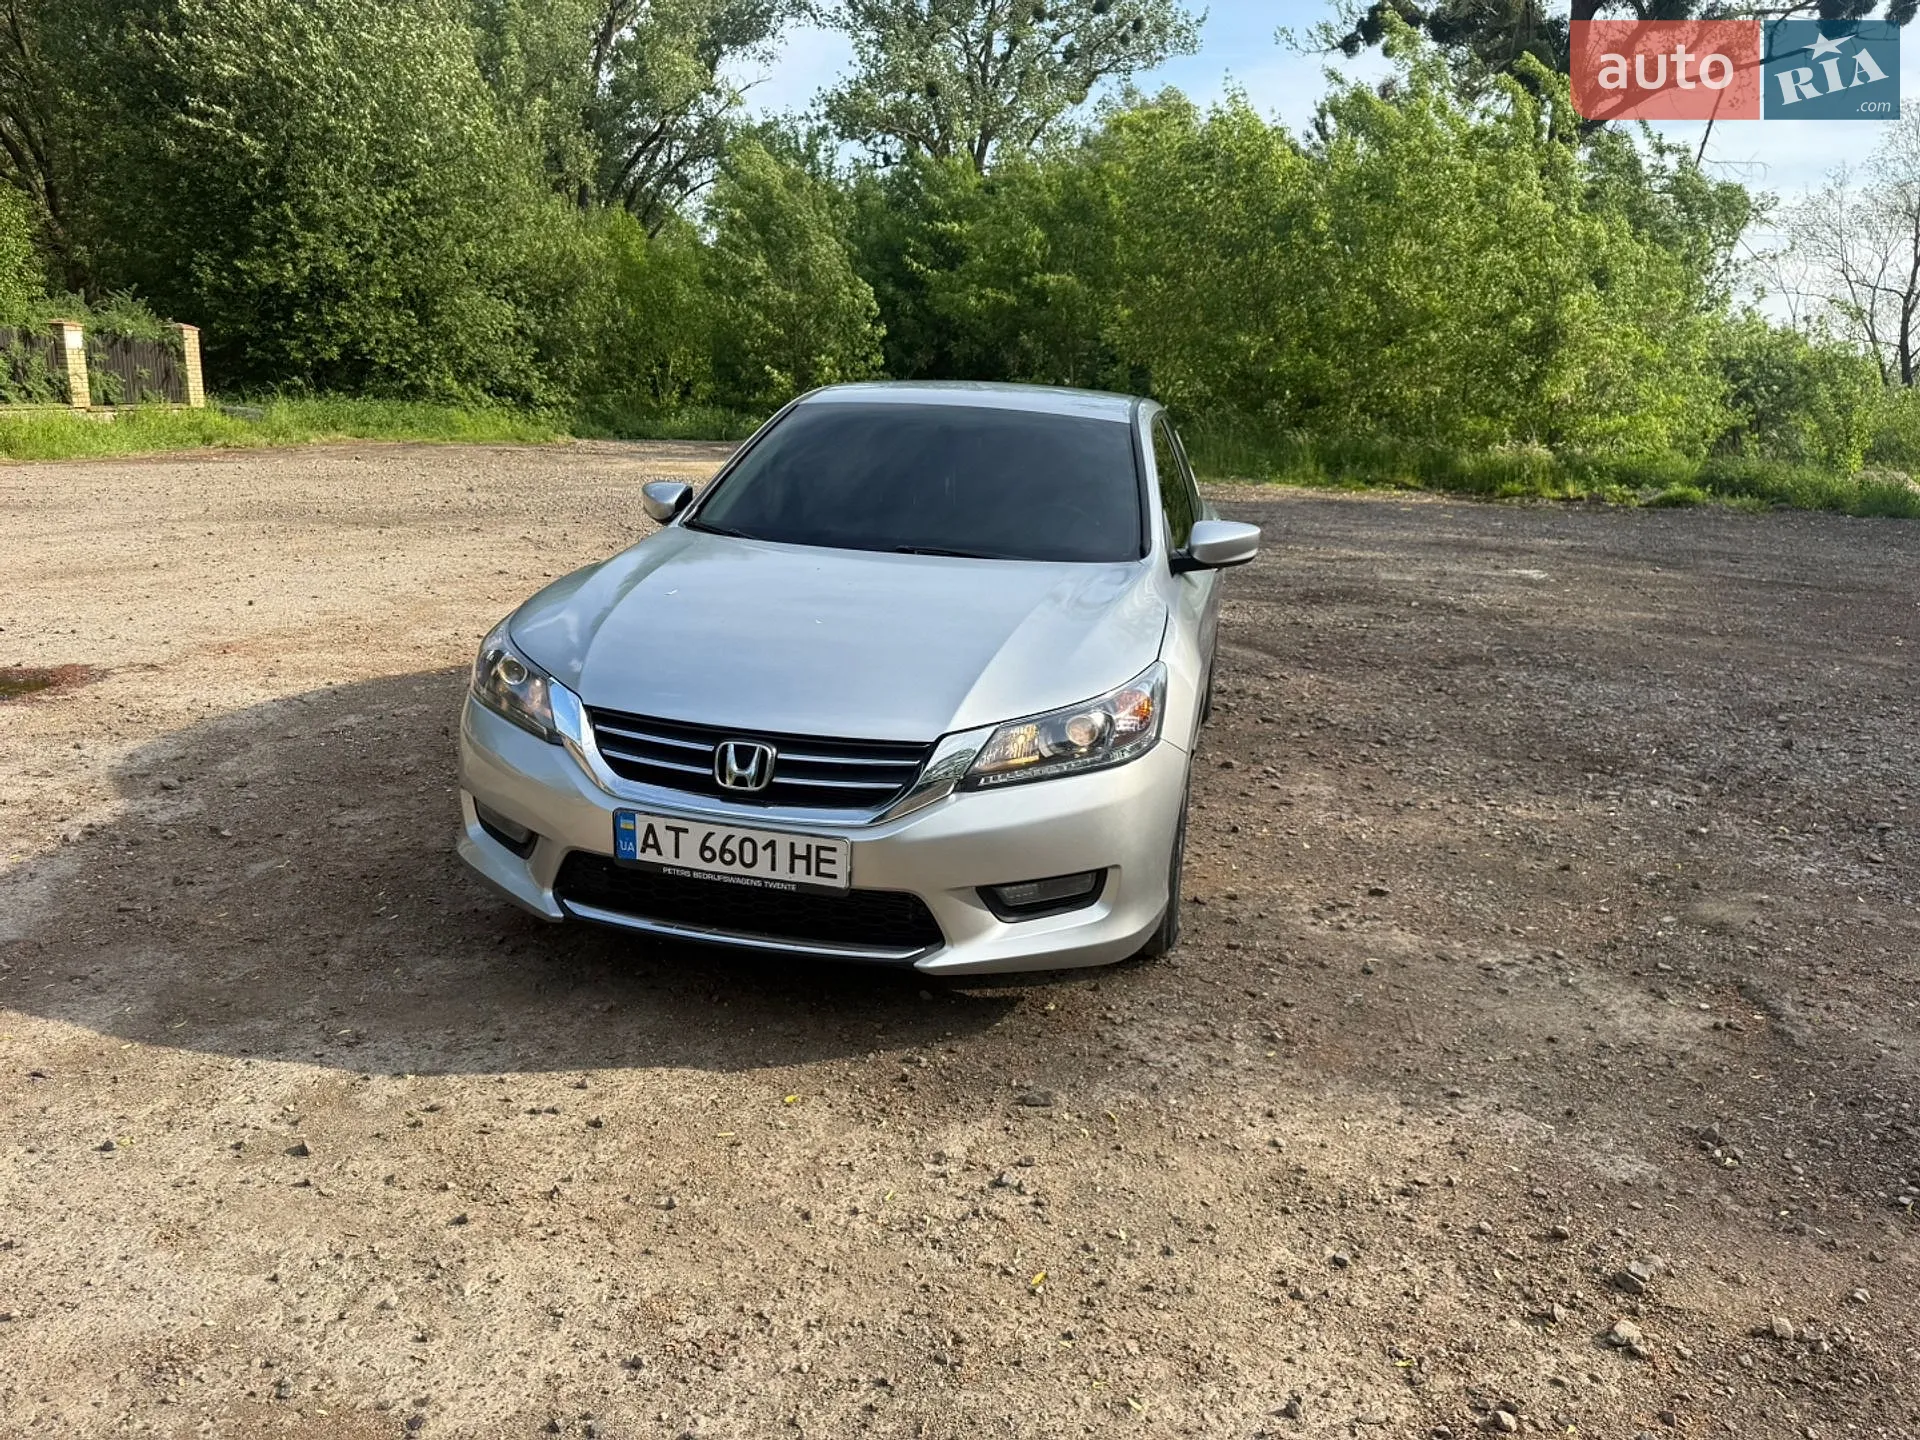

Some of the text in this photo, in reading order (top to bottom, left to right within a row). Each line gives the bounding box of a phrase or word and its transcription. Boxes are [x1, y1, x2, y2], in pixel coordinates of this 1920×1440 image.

[619, 840, 635, 852] UA
[640, 822, 838, 879] AT 6601 HE
[662, 867, 691, 878] PETERS
[764, 880, 797, 891] TWENTE
